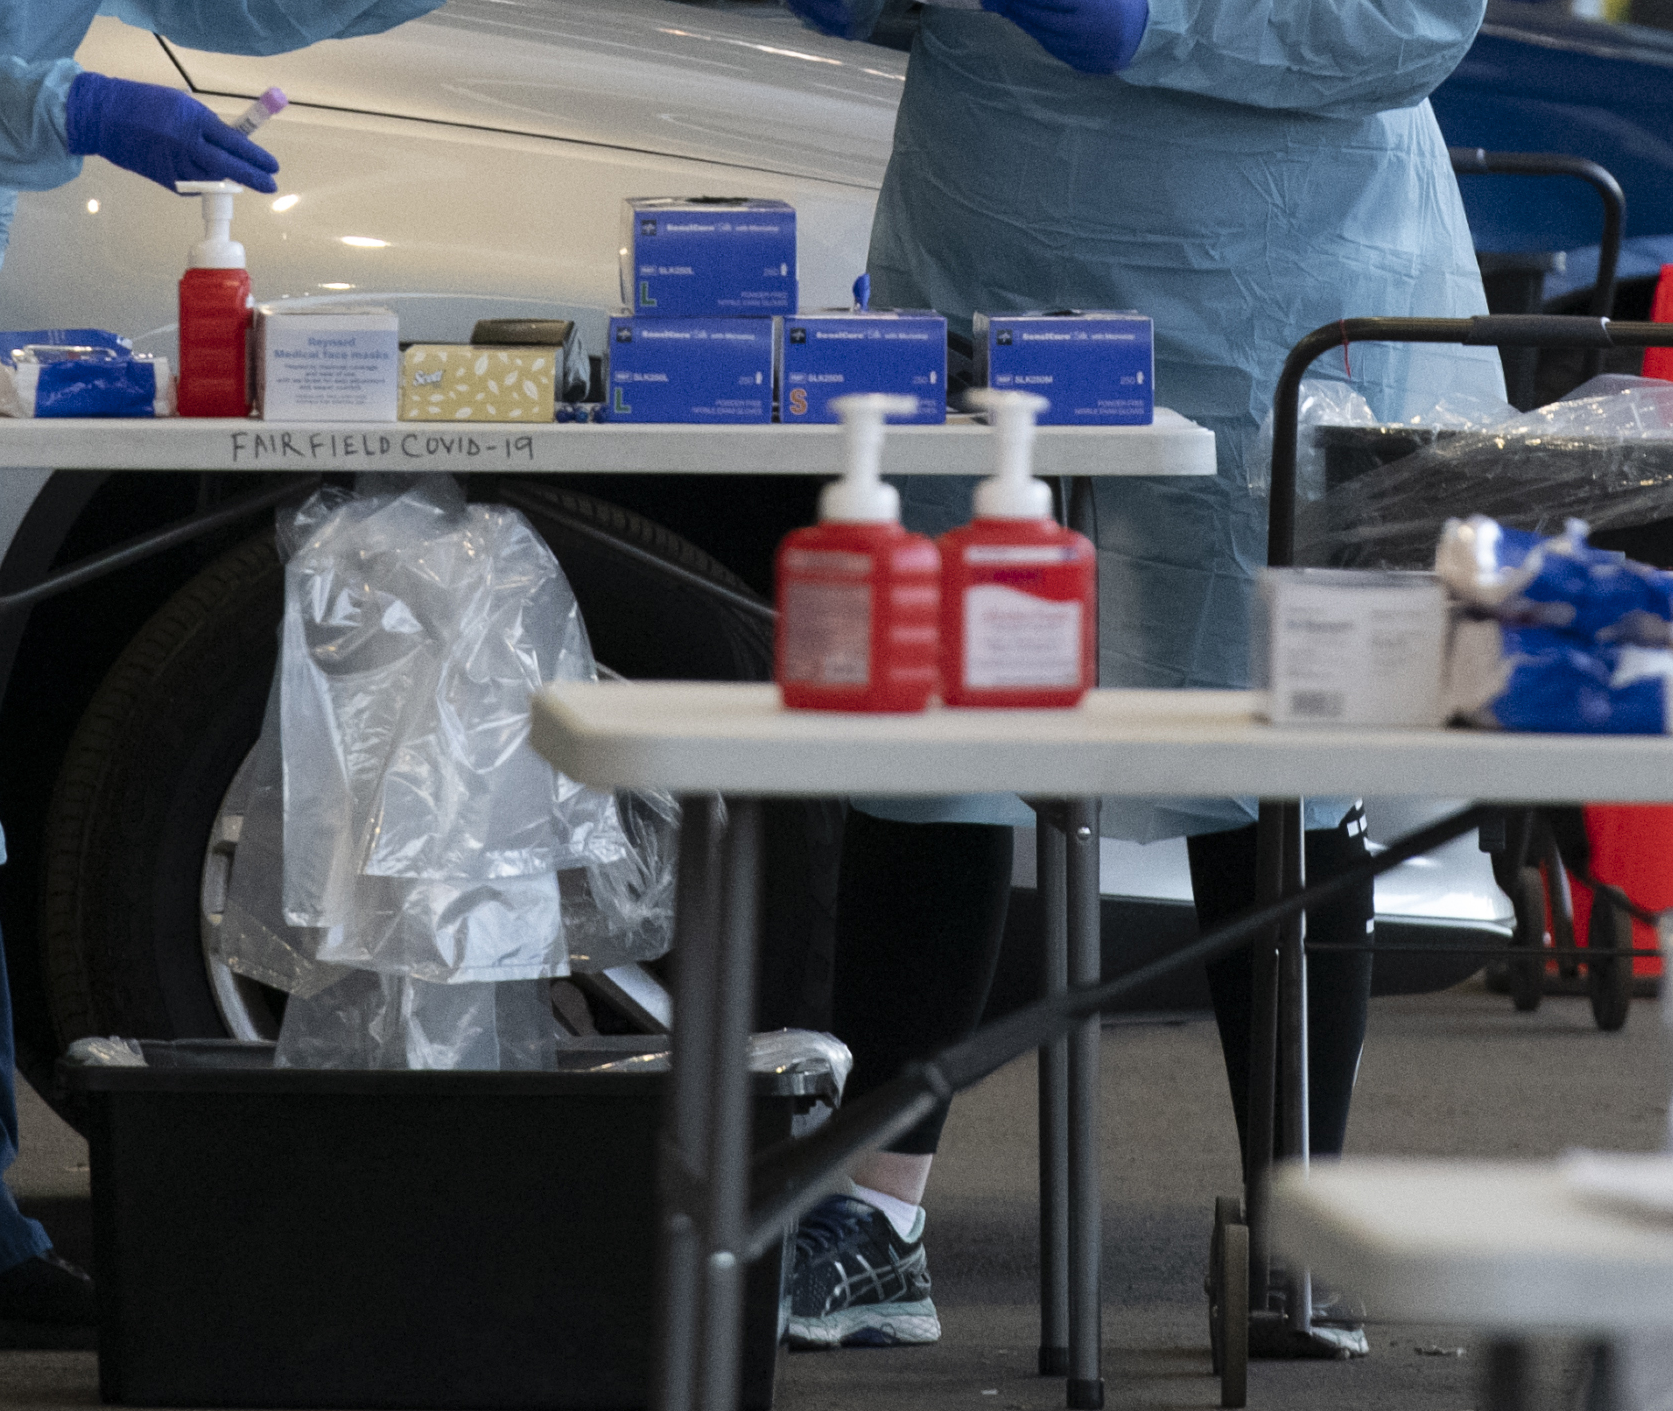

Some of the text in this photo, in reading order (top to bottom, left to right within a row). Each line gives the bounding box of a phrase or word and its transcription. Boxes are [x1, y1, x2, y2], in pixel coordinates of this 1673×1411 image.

[640, 281, 657, 307] L
[275, 349, 388, 359] Medical face masks
[614, 387, 631, 414] L
[789, 388, 808, 415] S
[230, 432, 534, 462] FAIRFIELD COVID-19
